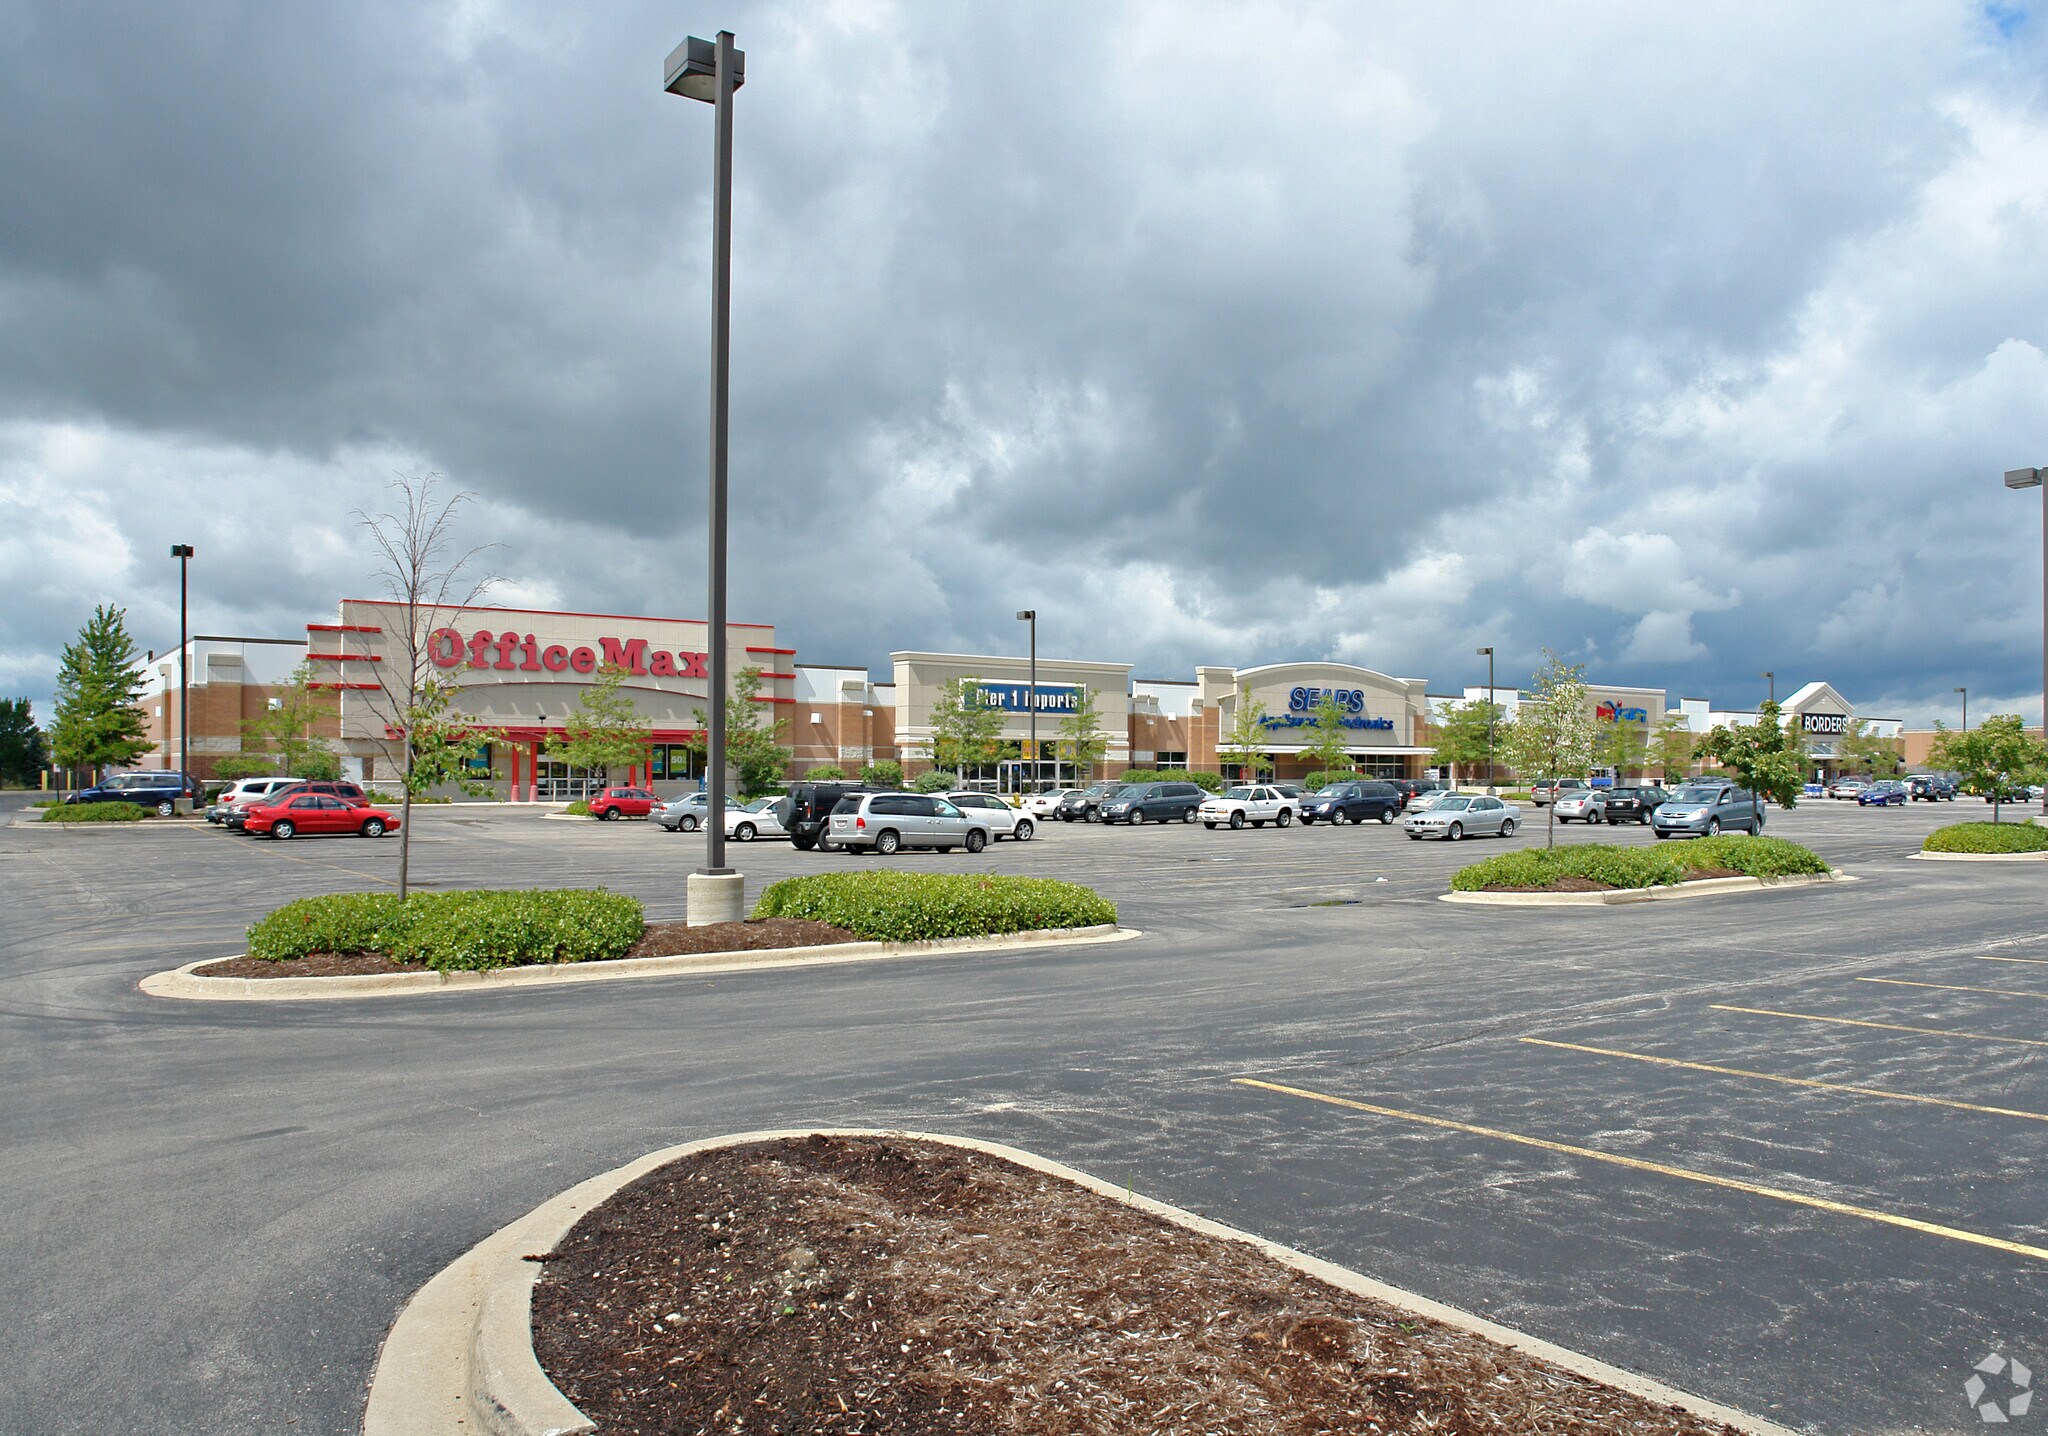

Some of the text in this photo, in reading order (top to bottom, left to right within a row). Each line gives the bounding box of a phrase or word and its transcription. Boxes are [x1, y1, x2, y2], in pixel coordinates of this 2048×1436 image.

[427, 627, 709, 680] OfficeMax
[1011, 689, 1018, 707] 1
[1804, 715, 1847, 733] BORDERS
